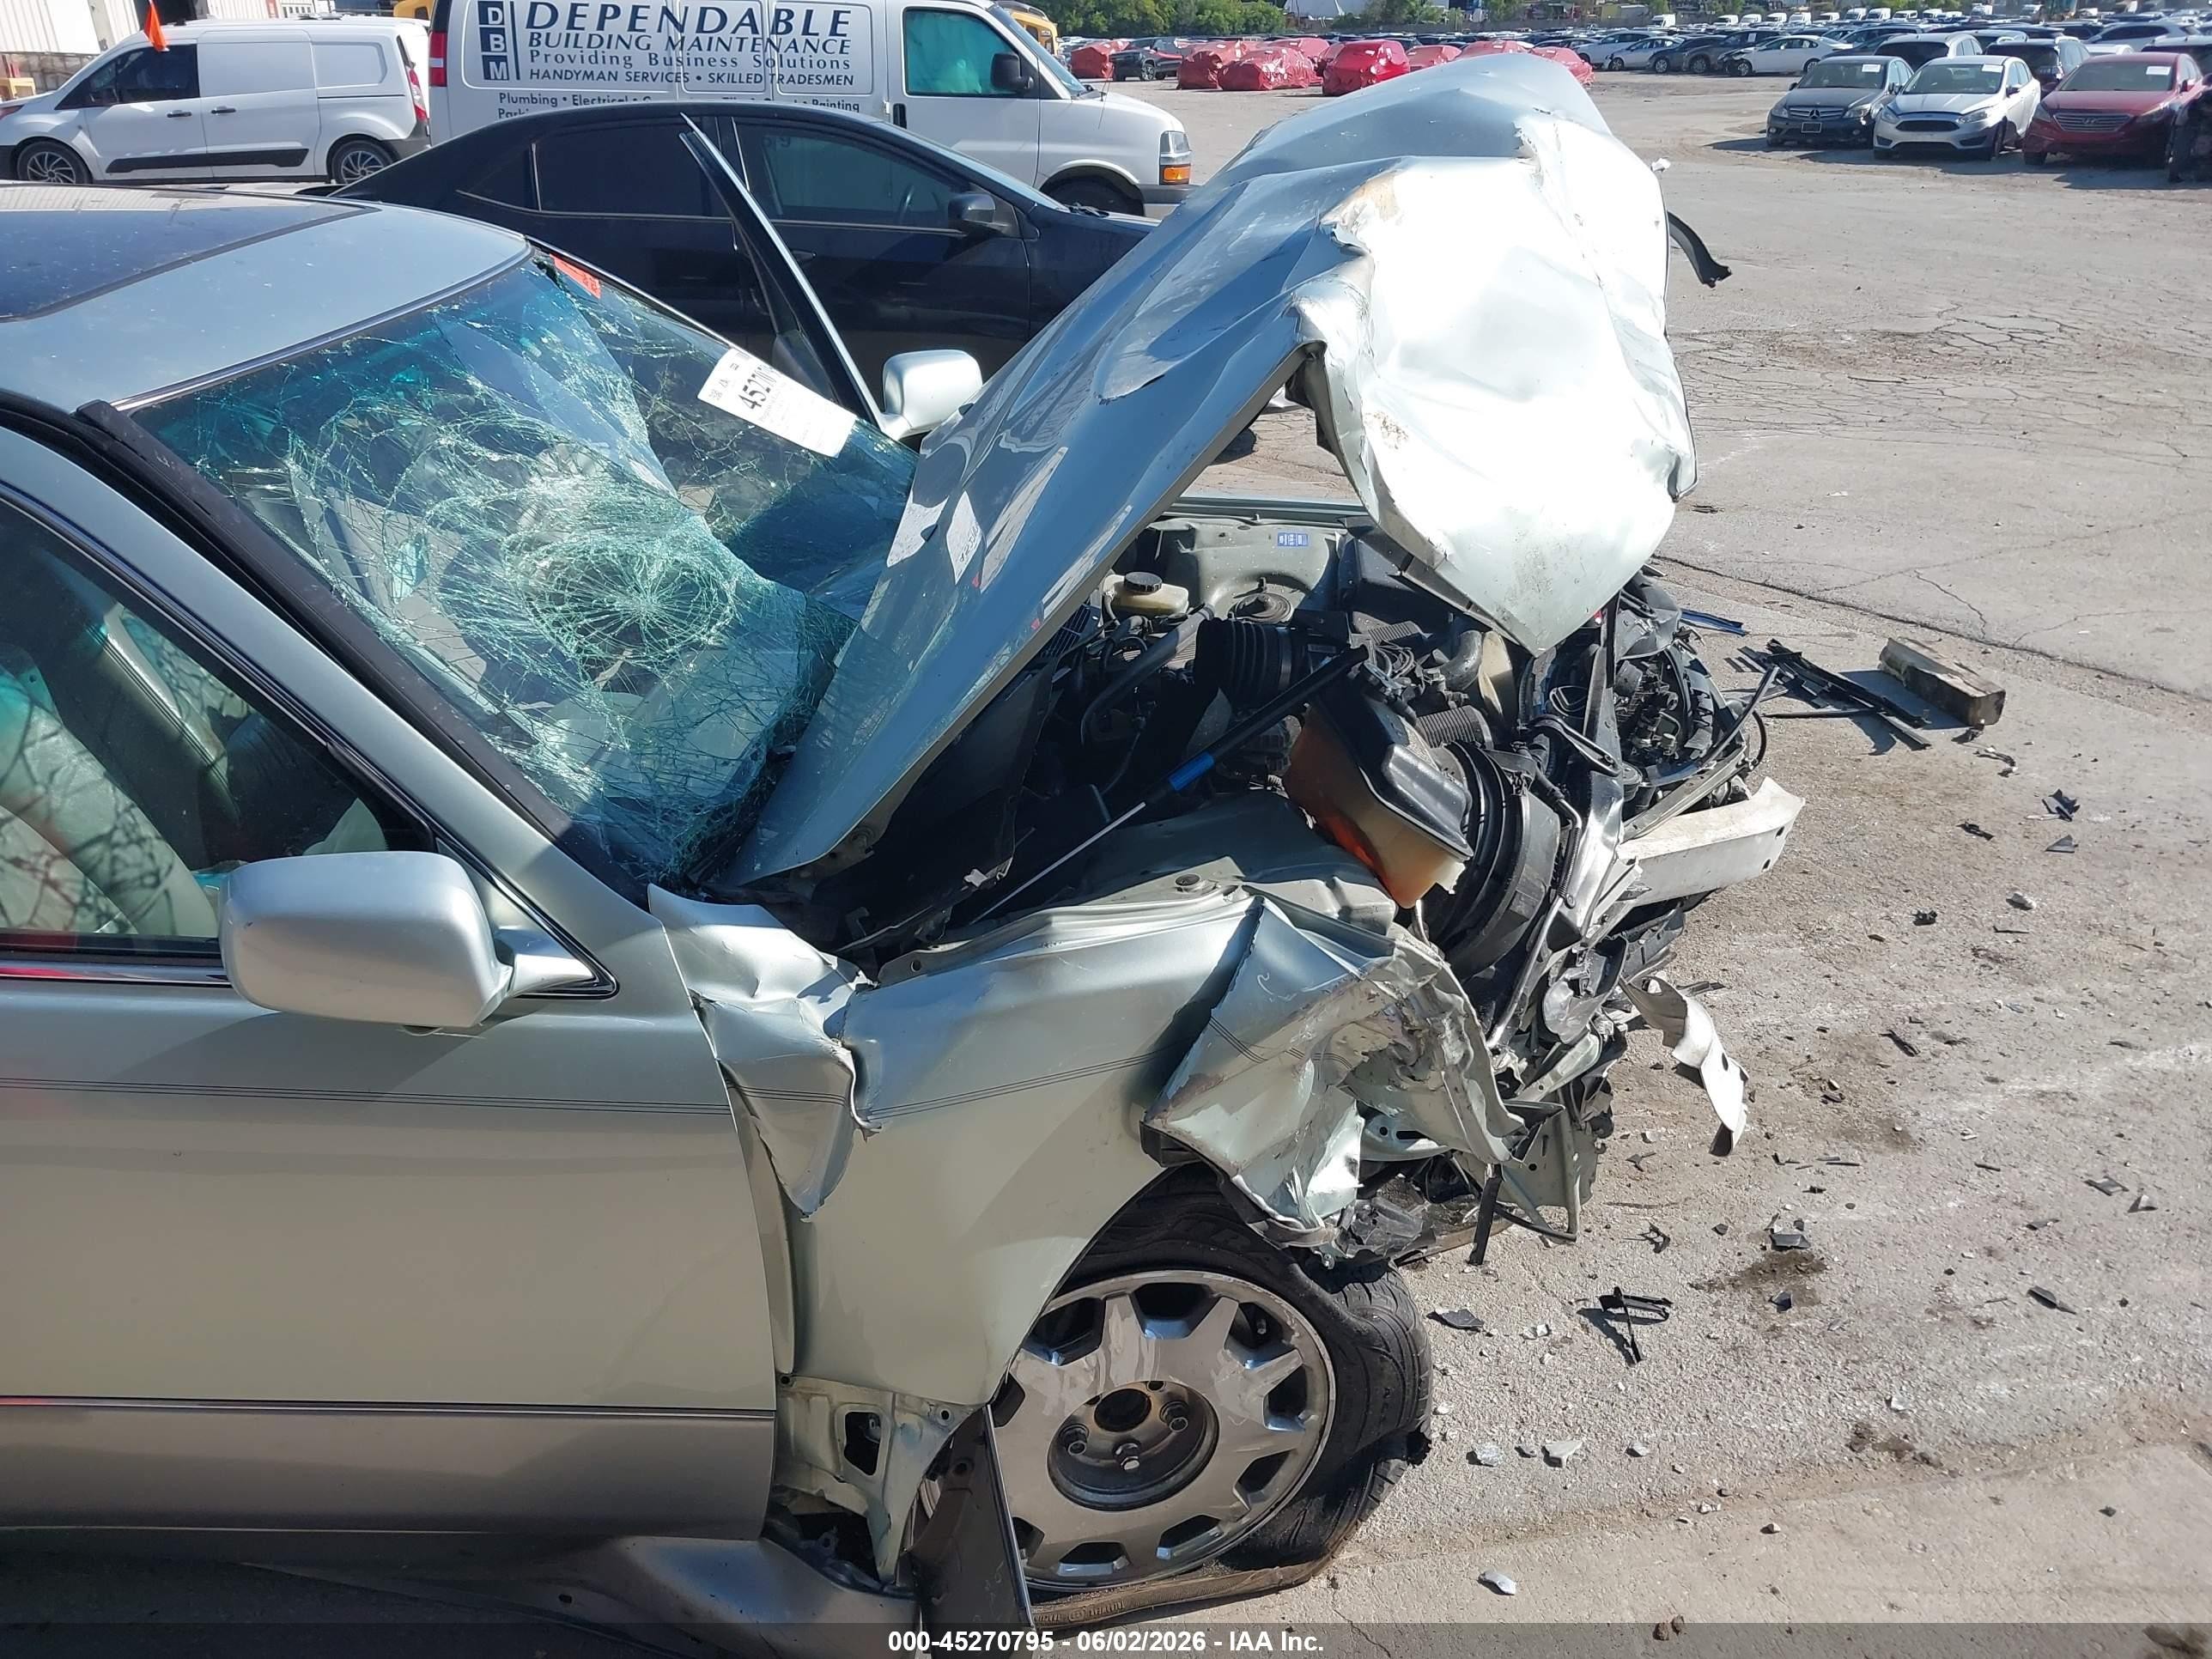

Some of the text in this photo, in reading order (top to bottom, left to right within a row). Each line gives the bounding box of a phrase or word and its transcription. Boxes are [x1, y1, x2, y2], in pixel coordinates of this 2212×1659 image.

[526, 1, 851, 37] DEPENDABLE
[528, 32, 851, 55] BUILDING MAINTENANCE
[530, 50, 850, 70] Providing Business Solutions
[530, 68, 854, 86] HANDYMAN SERVICES SKILLED TRADESMEN
[499, 92, 558, 107] Plumbing
